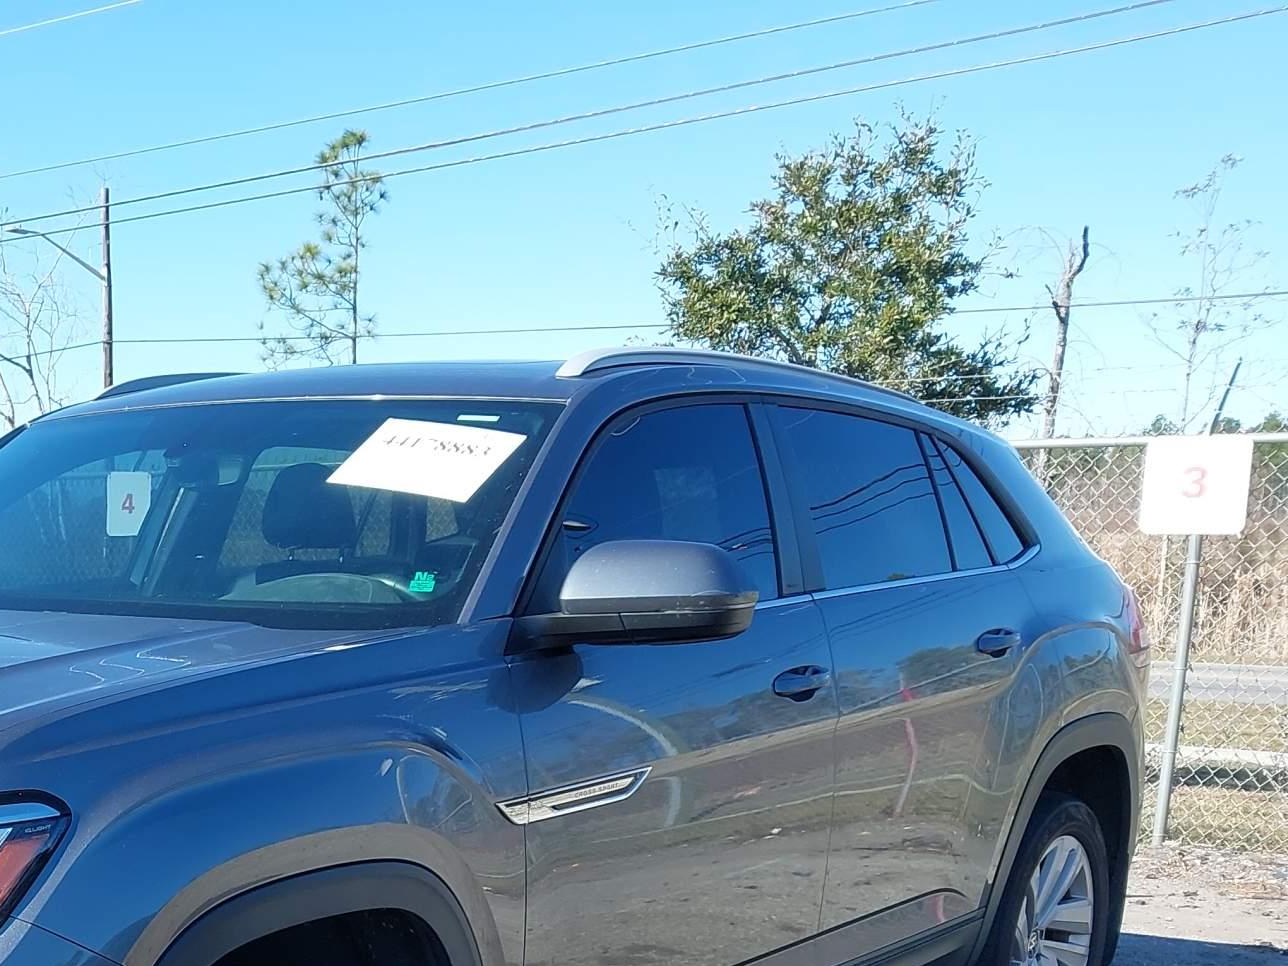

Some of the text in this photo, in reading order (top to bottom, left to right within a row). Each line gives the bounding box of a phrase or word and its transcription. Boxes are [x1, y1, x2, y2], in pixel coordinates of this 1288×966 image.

[1182, 466, 1209, 499] 3
[121, 493, 136, 515] 4
[574, 782, 619, 798] CROSS SPORT
